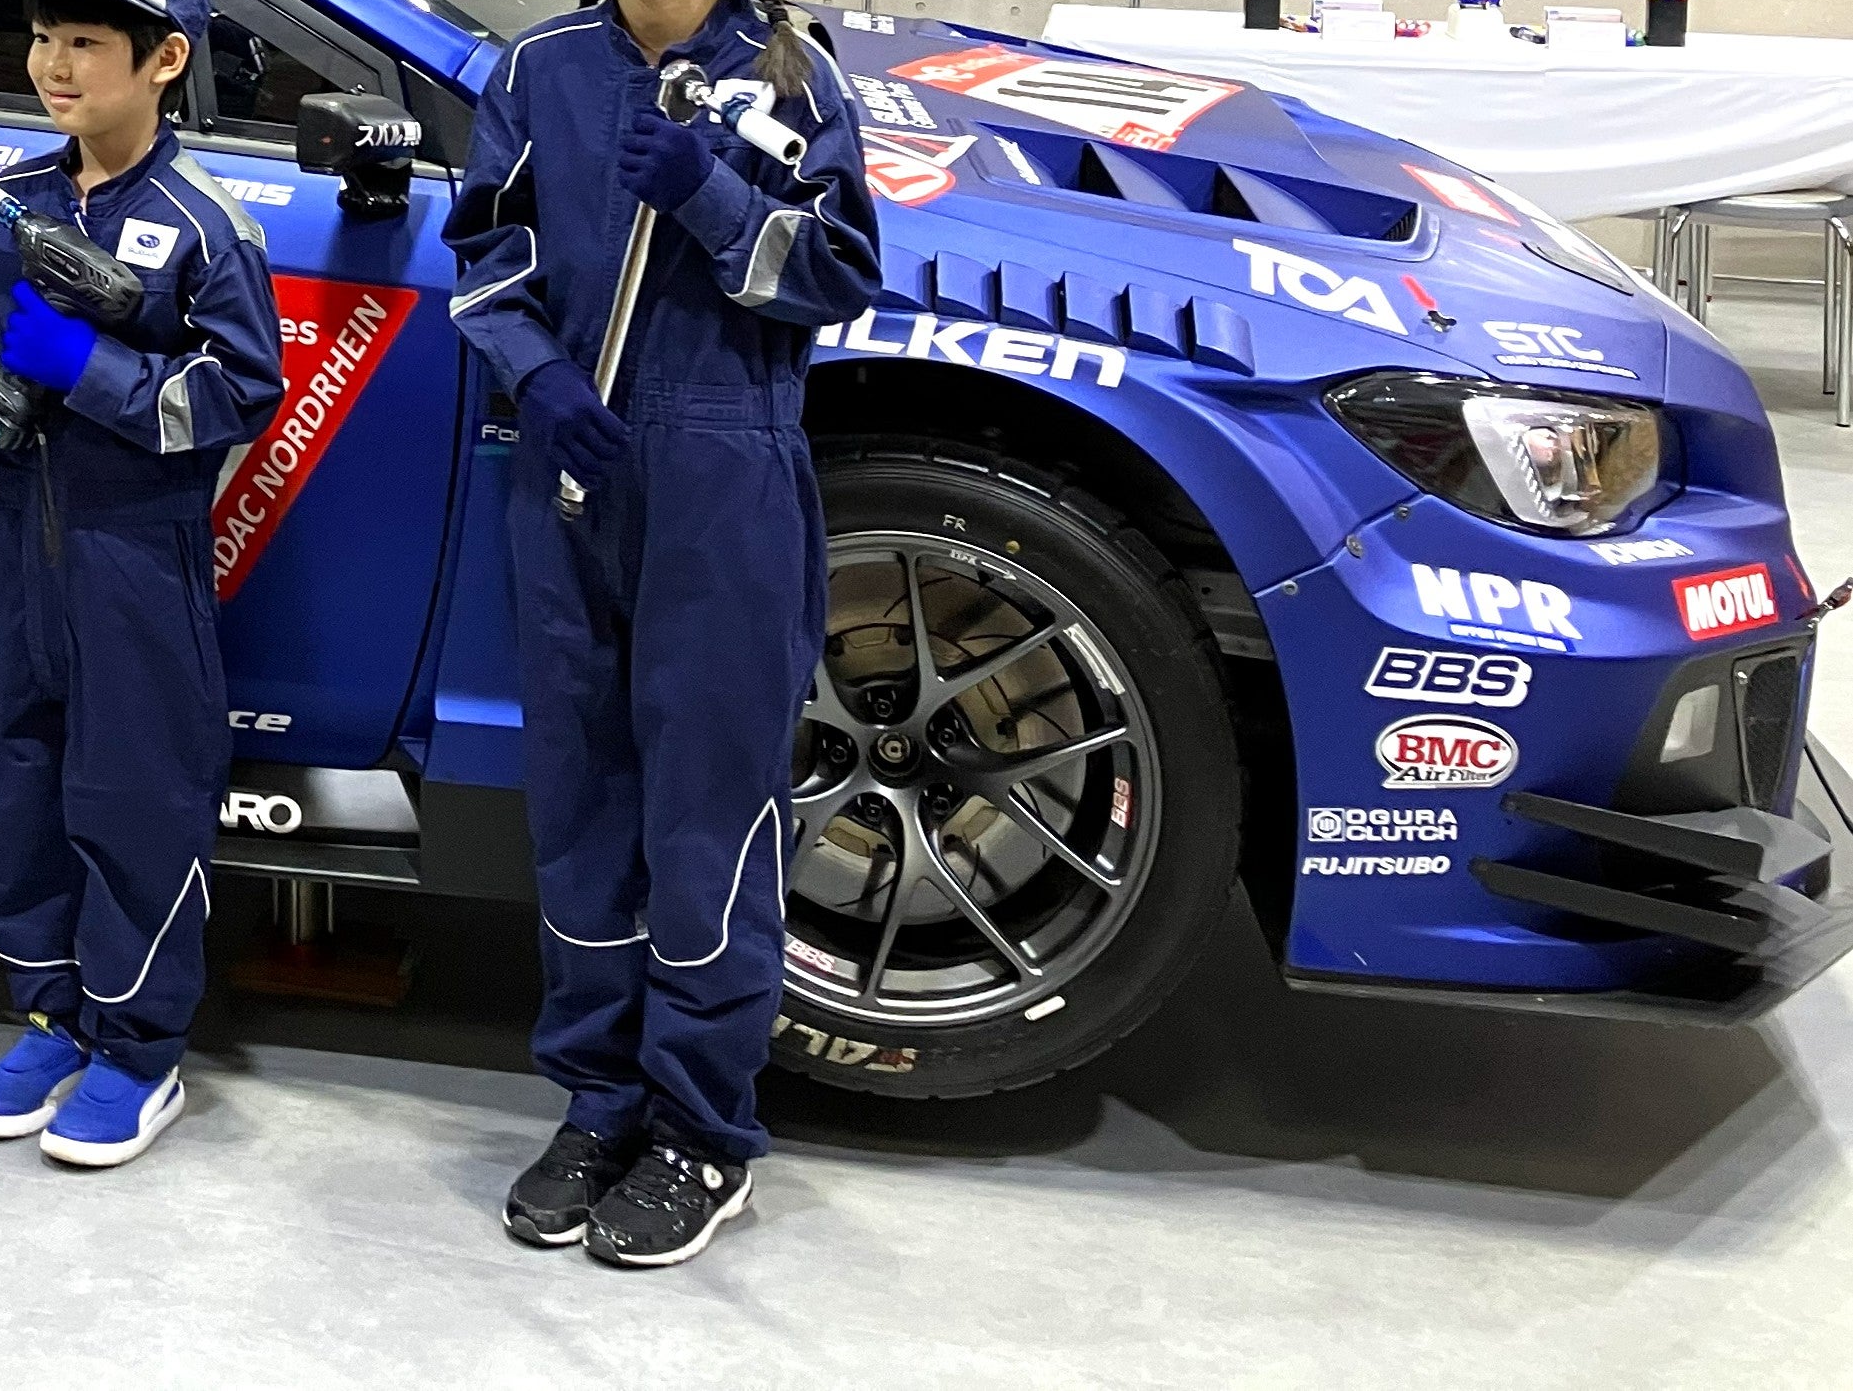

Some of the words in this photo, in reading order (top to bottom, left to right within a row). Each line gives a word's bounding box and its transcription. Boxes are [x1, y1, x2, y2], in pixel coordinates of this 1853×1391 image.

[1232, 238, 1409, 336] TOA
[1482, 320, 1604, 361] STC
[252, 293, 388, 500] NORDRHEIN
[943, 514, 966, 532] FR
[1411, 563, 1583, 640] NPR
[1684, 573, 1774, 632] MOTUL
[1366, 648, 1528, 704] BBS
[1394, 733, 1501, 769] BMC
[1394, 766, 1446, 782] Air
[1447, 768, 1490, 782] Filter
[1346, 808, 1458, 825] OGURA
[1346, 825, 1458, 842] CLUTCH
[1301, 856, 1451, 876] FUJITSUBO
